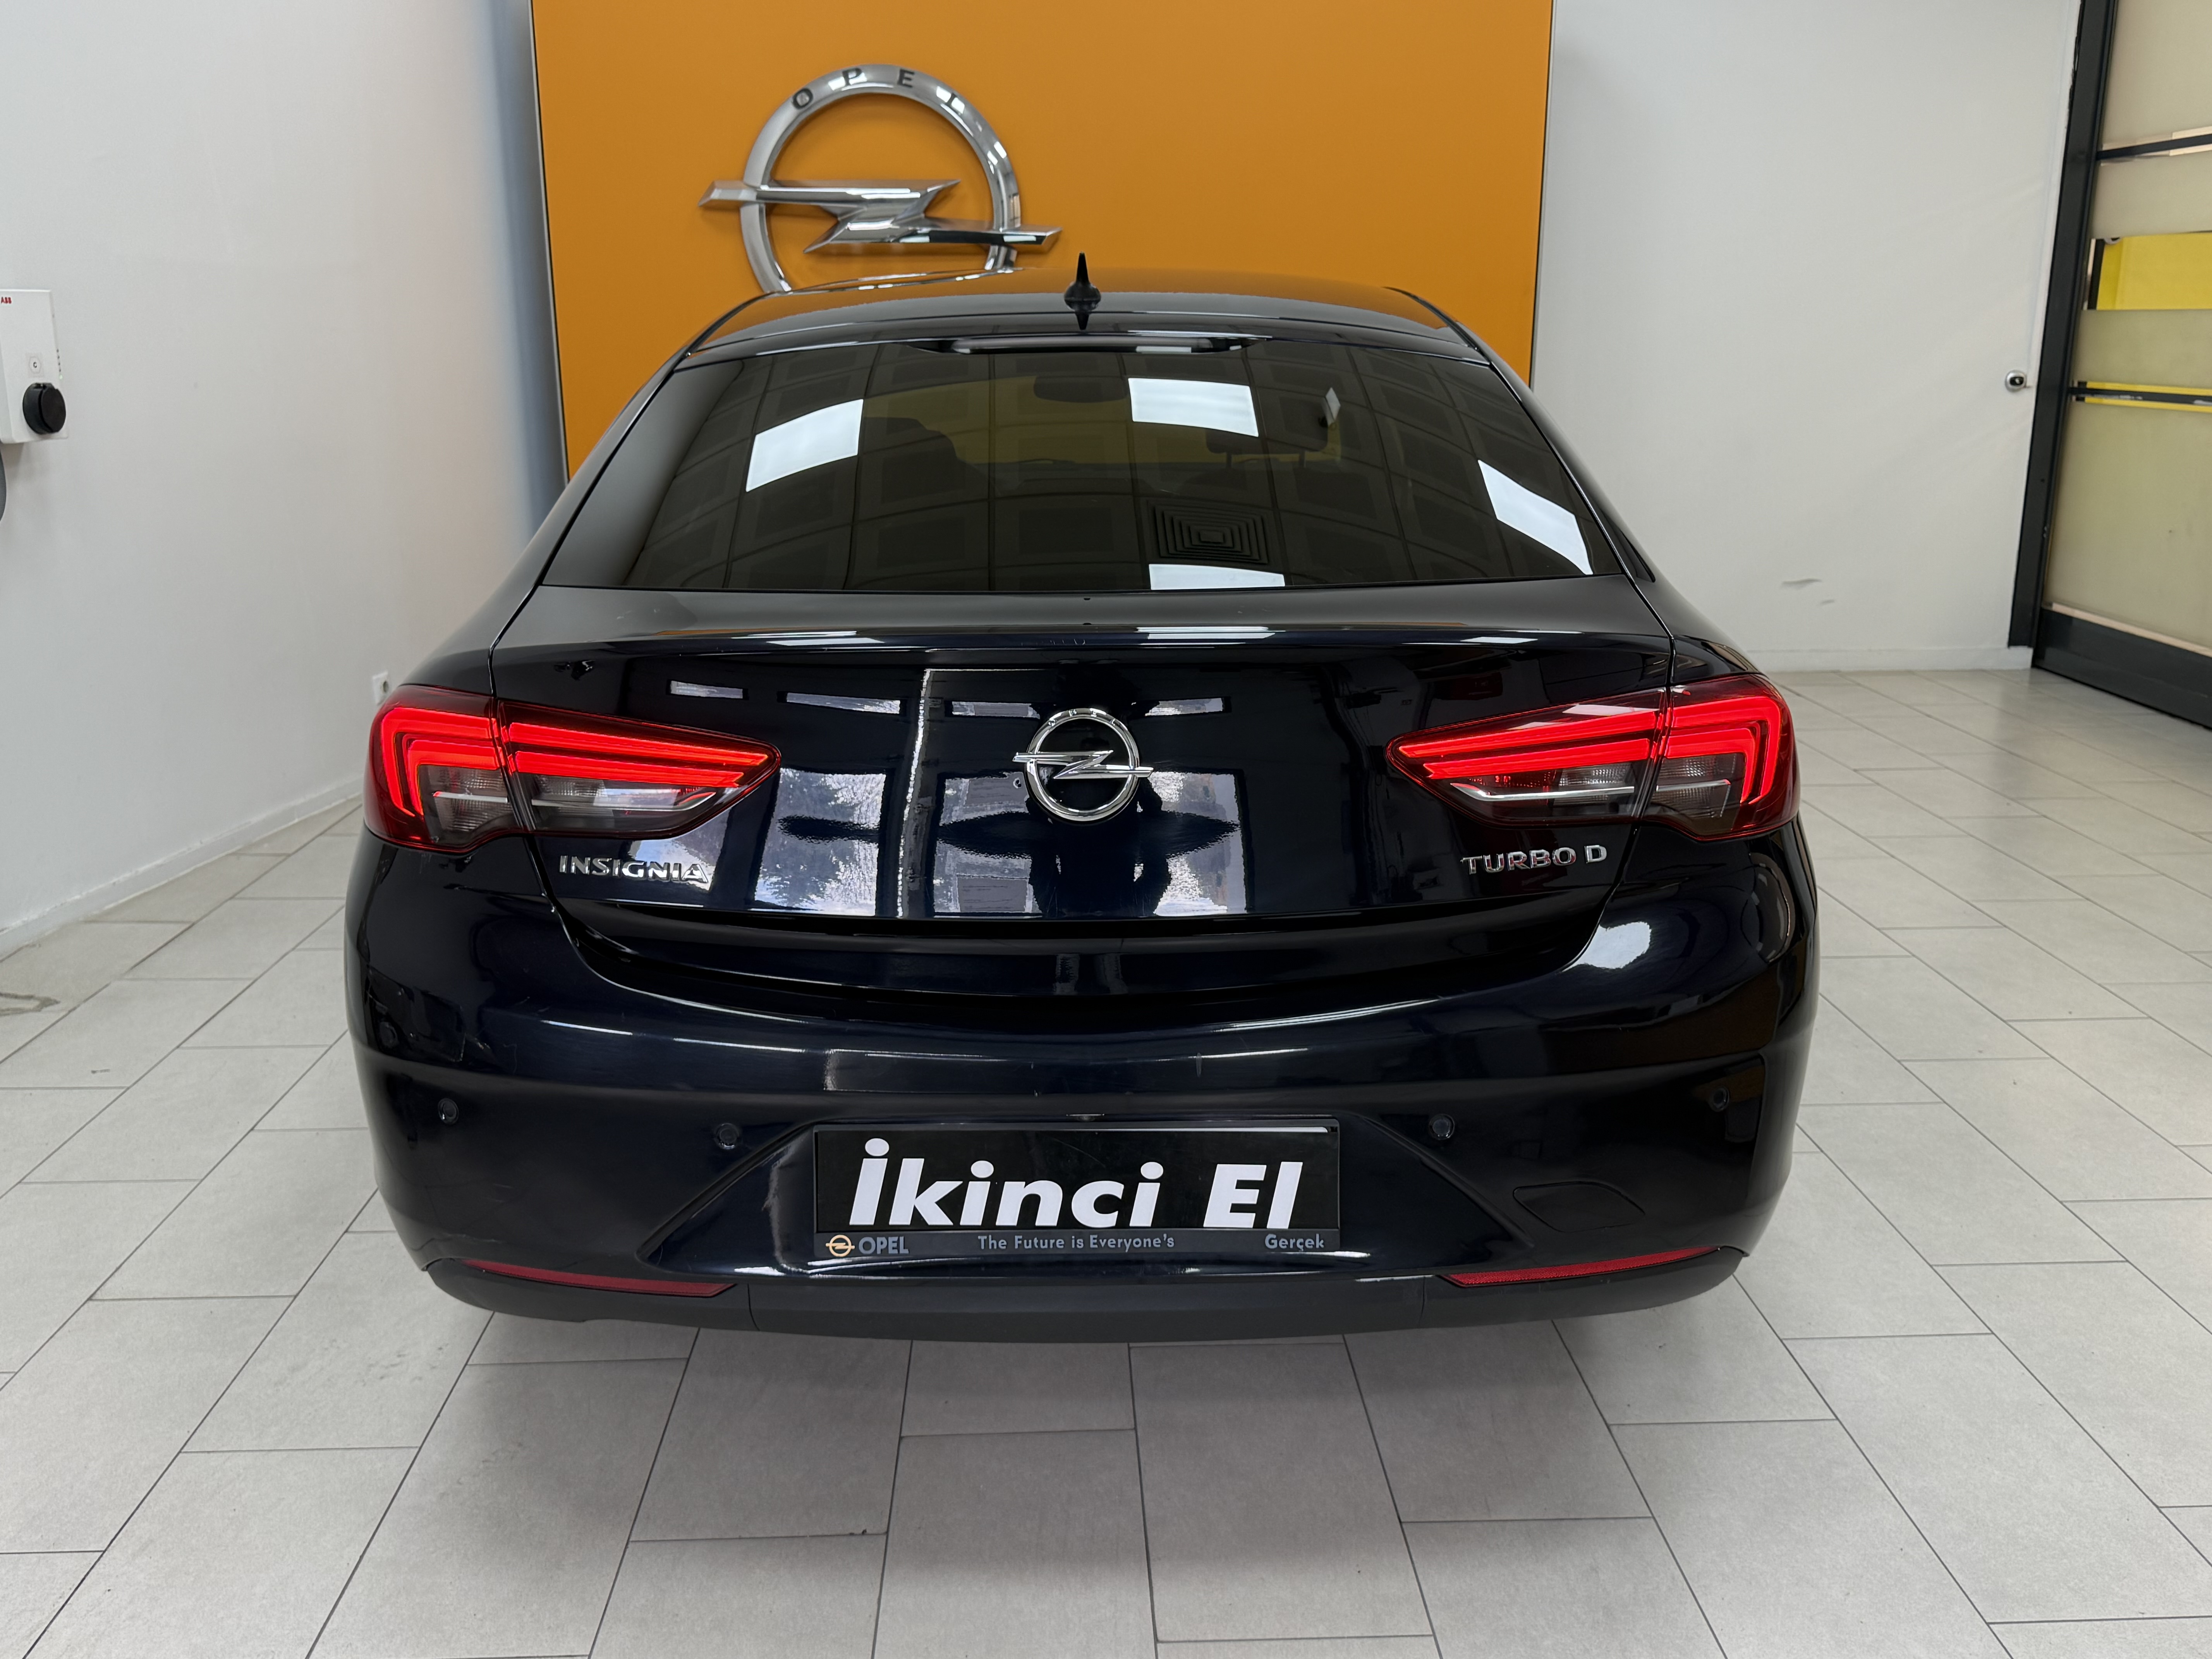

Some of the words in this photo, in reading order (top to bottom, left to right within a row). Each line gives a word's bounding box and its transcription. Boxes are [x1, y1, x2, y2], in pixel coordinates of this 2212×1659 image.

[792, 67, 962, 114] OPEL
[559, 855, 708, 883] INSIGNIA
[1460, 847, 1577, 874] TURBO
[1584, 845, 1607, 864] D
[849, 1138, 1163, 1228] İkinci
[1203, 1161, 1303, 1229] El
[859, 1236, 909, 1254] OPEL
[978, 1235, 1006, 1250] The
[1015, 1235, 1065, 1250] Future
[1072, 1235, 1084, 1249] is
[1090, 1233, 1174, 1252] Everyone's
[1265, 1233, 1324, 1251] Gerçek
